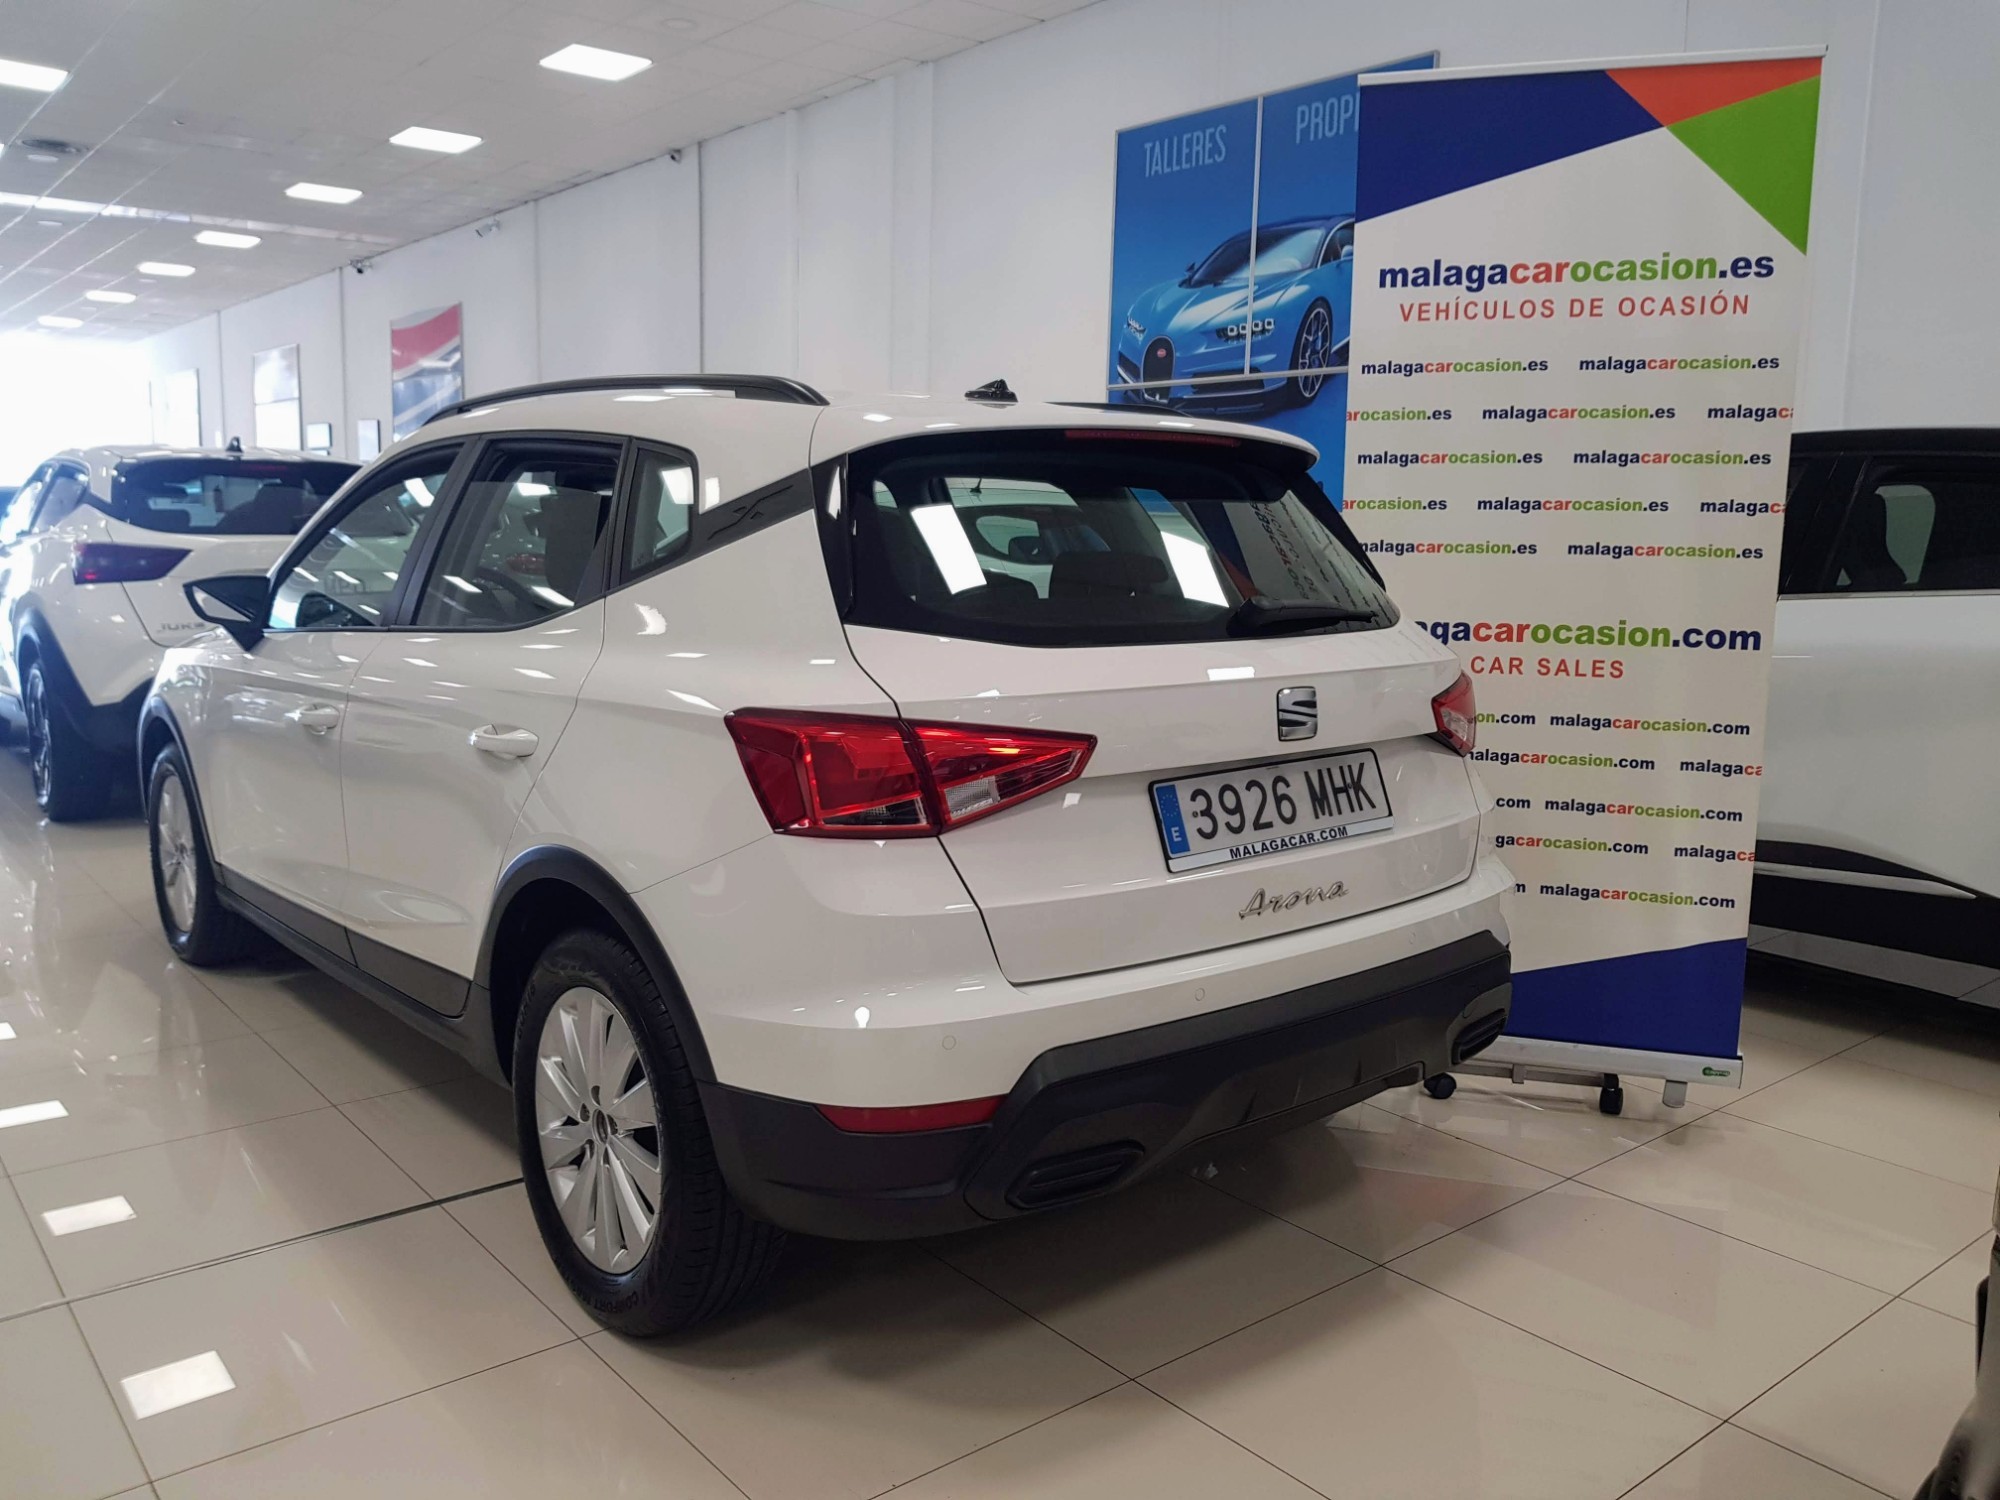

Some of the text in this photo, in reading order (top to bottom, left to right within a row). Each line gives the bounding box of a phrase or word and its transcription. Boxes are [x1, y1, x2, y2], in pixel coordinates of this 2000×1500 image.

[1144, 125, 1227, 177] TALLERES
[1379, 252, 1774, 294] malagacarocasion.es
[1399, 290, 1748, 322] VEHÍCULOS DE OCASIÓN
[1361, 355, 1779, 377] malagacarocasion.es malagacarocasion.es
[1482, 404, 1676, 422] malagacarocasion.es
[1357, 449, 1771, 468] malagacarocasion.es malagacarocasion.es
[1477, 496, 1669, 515] malagacarocasion.es
[1568, 541, 1763, 560] malagacarocasion.es
[1470, 656, 1625, 679] CAR SALES
[1550, 714, 1750, 735] malagacarocasion.com
[1171, 763, 1376, 842] E 3926 MHK
[1545, 799, 1742, 822] malagacarocasion.com
[1229, 826, 1349, 860] MALAGACAR.COM
[1238, 880, 1350, 920] Arona
[1540, 884, 1735, 908] malagacarocasion.com
